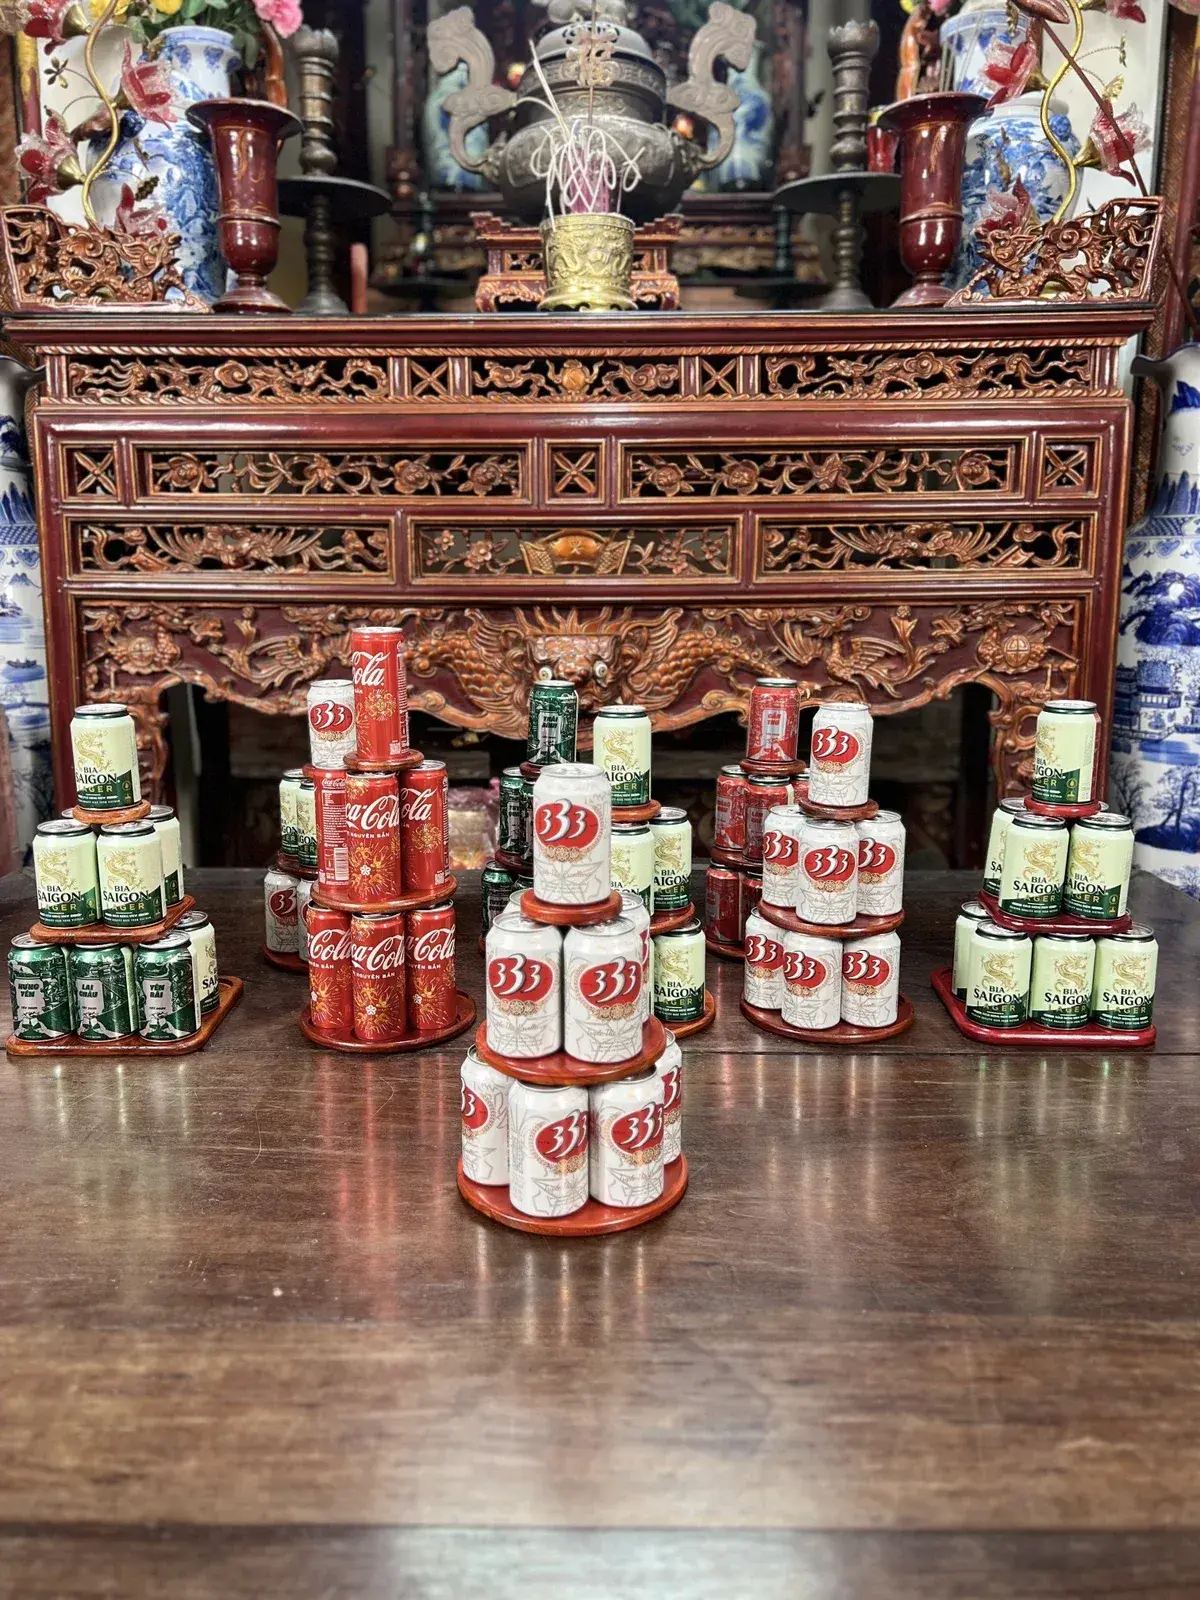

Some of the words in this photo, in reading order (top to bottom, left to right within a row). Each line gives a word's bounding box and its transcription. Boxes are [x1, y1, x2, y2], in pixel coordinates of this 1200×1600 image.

[314, 700, 345, 729] 333
[814, 725, 849, 758] 333
[604, 771, 643, 782] AIGON
[1036, 778, 1057, 787] GER
[539, 798, 587, 842] 333
[764, 830, 793, 860] 333
[810, 844, 848, 878] 333
[653, 875, 689, 887] AIGON
[1074, 873, 1088, 881] BIA
[657, 886, 685, 894] AGER
[1013, 880, 1060, 895] SAIGON
[1066, 878, 1107, 896] AIGON
[38, 890, 81, 903] SAIGON
[103, 890, 151, 904] SAIGON
[1070, 891, 1100, 903] AGER
[747, 934, 777, 962] 333
[785, 950, 816, 980] 333
[845, 950, 881, 980] 333
[492, 953, 542, 995] 333
[588, 956, 636, 1003] 333
[654, 984, 697, 998] SAIGON
[973, 988, 1021, 1004] SAIGON
[989, 985, 1005, 993] BIA
[1044, 992, 1090, 1006] SAIGON
[1102, 992, 1152, 1006] SAIGON
[976, 1001, 1016, 1013] LAGER
[620, 1102, 662, 1149] 333
[545, 1109, 588, 1158] 333
